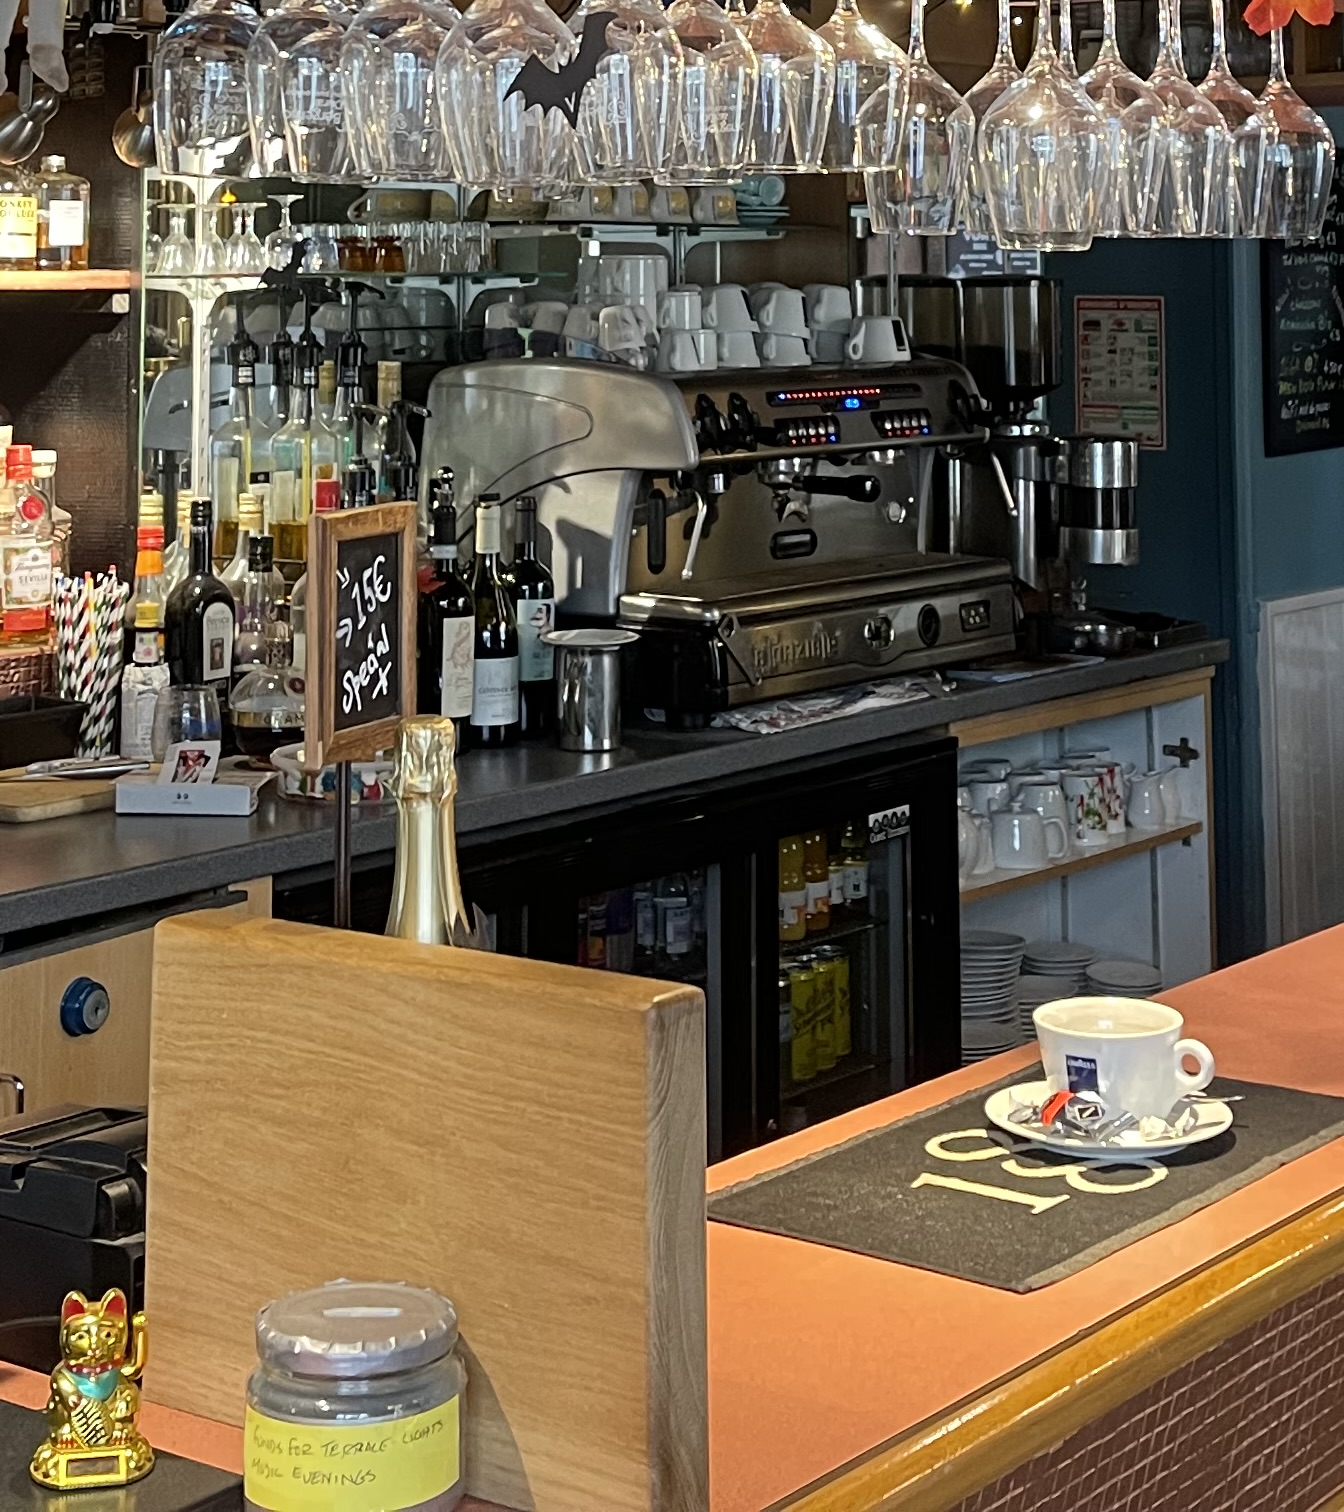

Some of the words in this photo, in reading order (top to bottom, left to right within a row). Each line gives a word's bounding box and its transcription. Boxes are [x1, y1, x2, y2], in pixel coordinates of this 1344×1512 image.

[352, 554, 392, 630] 15€
[288, 1437, 314, 1456] FOR
[291, 1465, 378, 1486] EVENINGS
